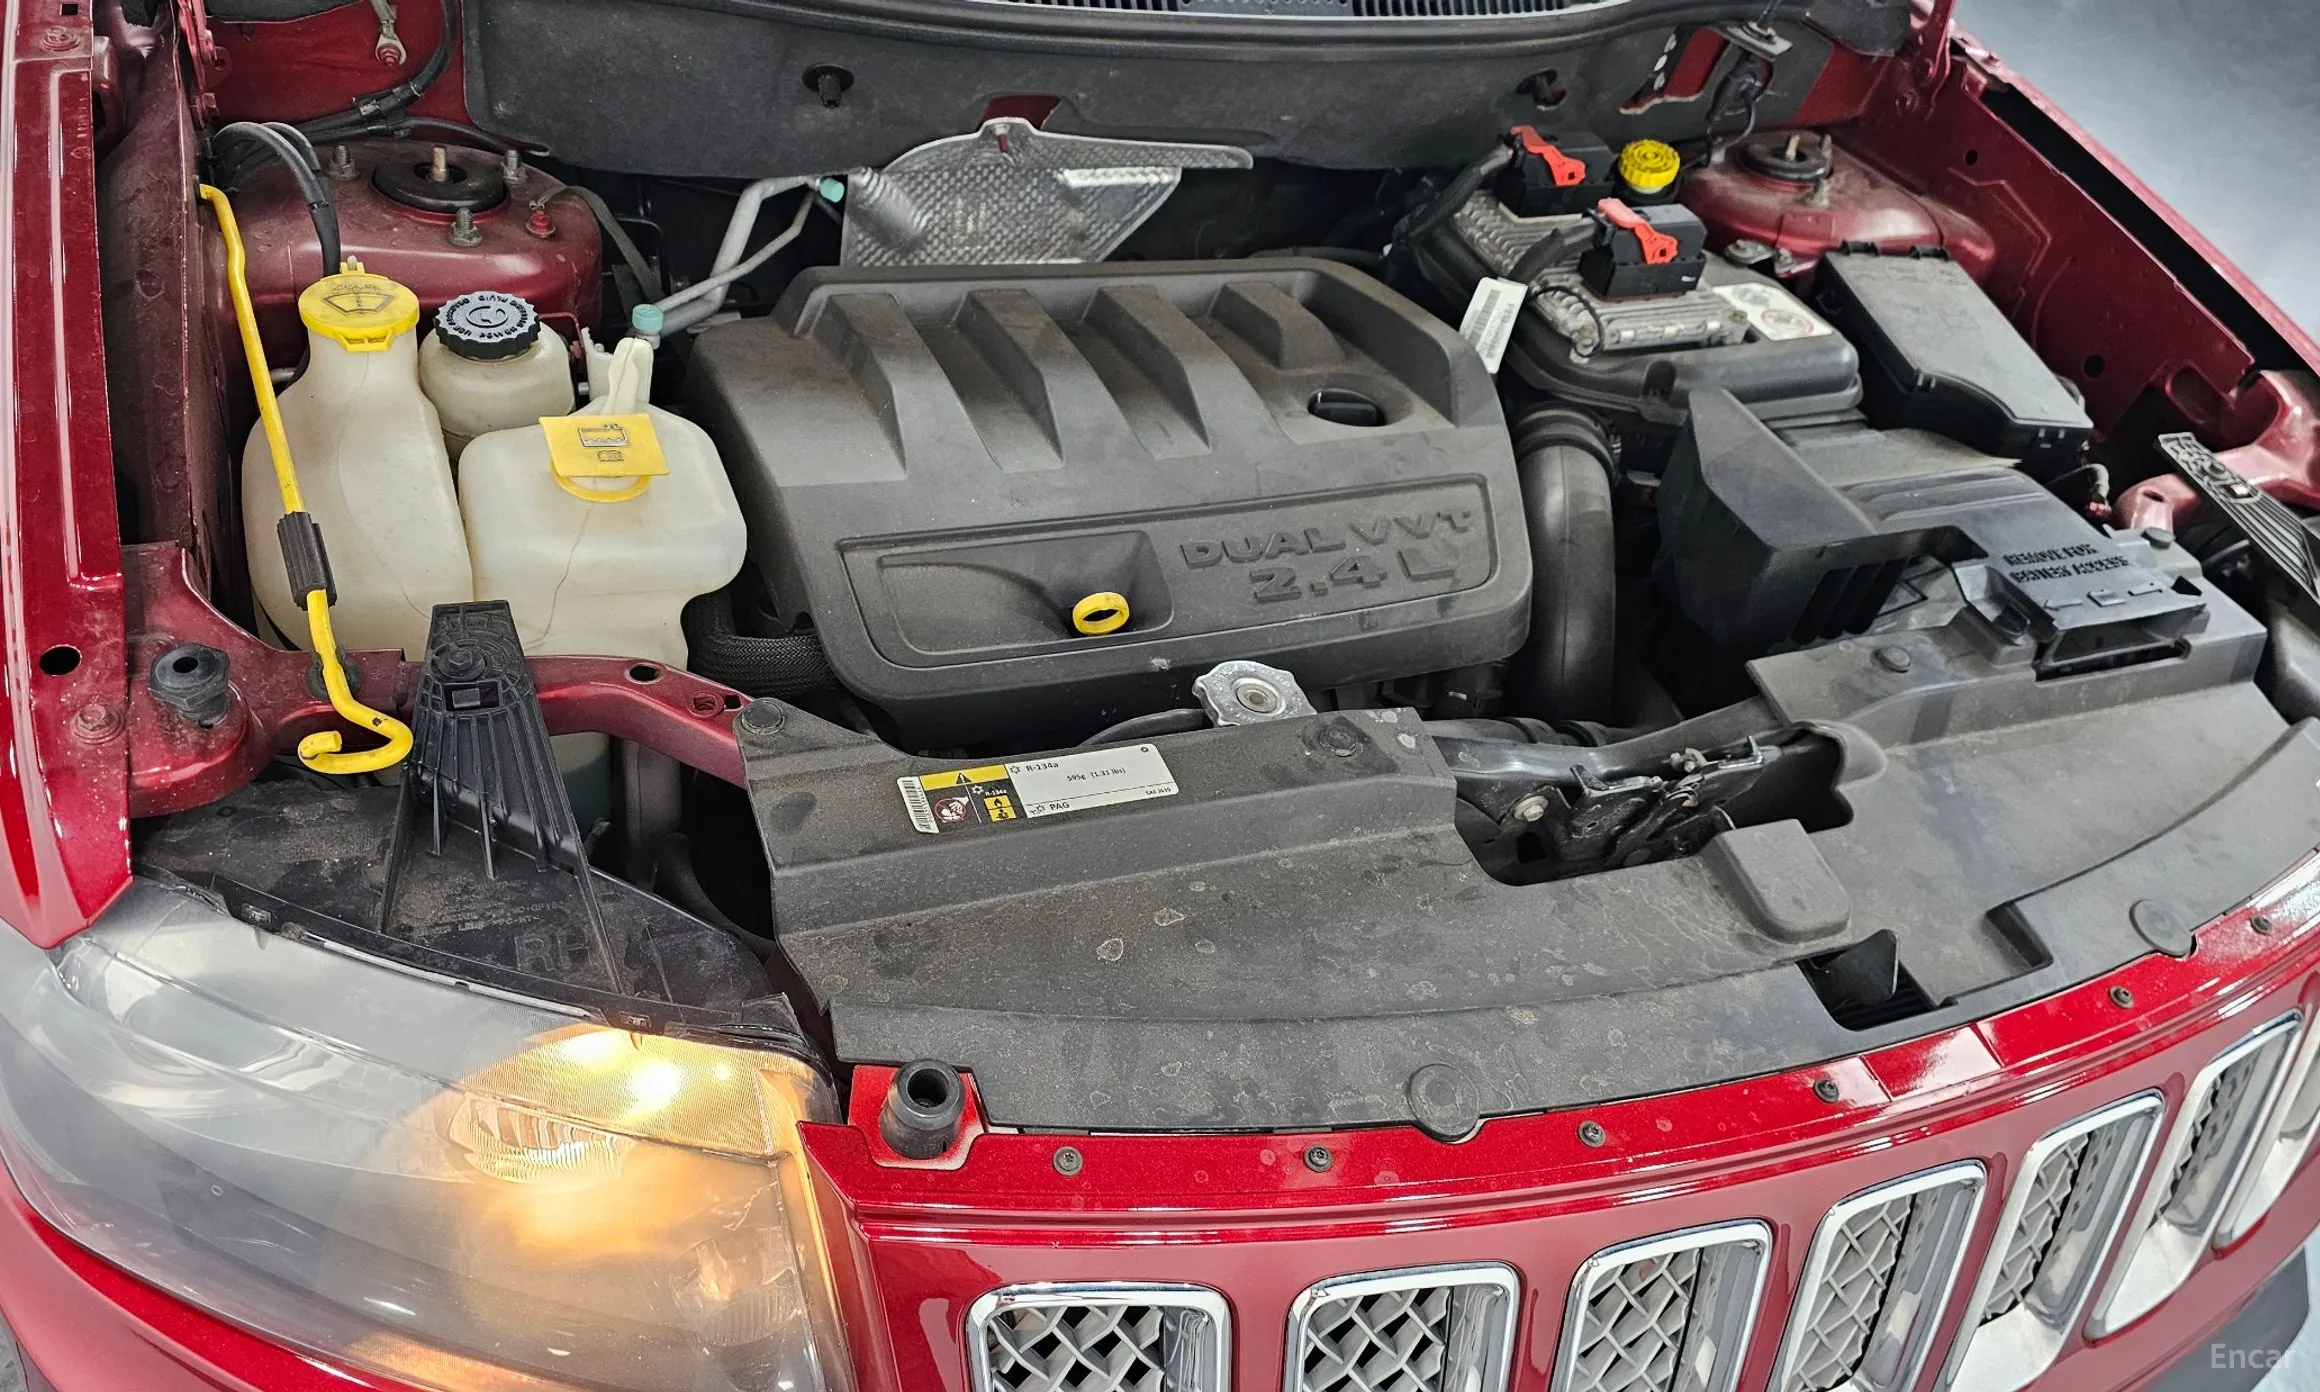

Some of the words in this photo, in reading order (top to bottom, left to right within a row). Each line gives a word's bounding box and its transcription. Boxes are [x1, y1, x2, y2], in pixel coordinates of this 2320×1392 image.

[1179, 525, 1347, 569] DUAL
[1348, 510, 1471, 546] VVT
[2003, 548, 2062, 566] REMOVE
[2062, 542, 2098, 557] FOR
[2073, 555, 2129, 576] ACCESS
[1025, 762, 1059, 773] R-134a
[1049, 801, 1071, 811] PAG
